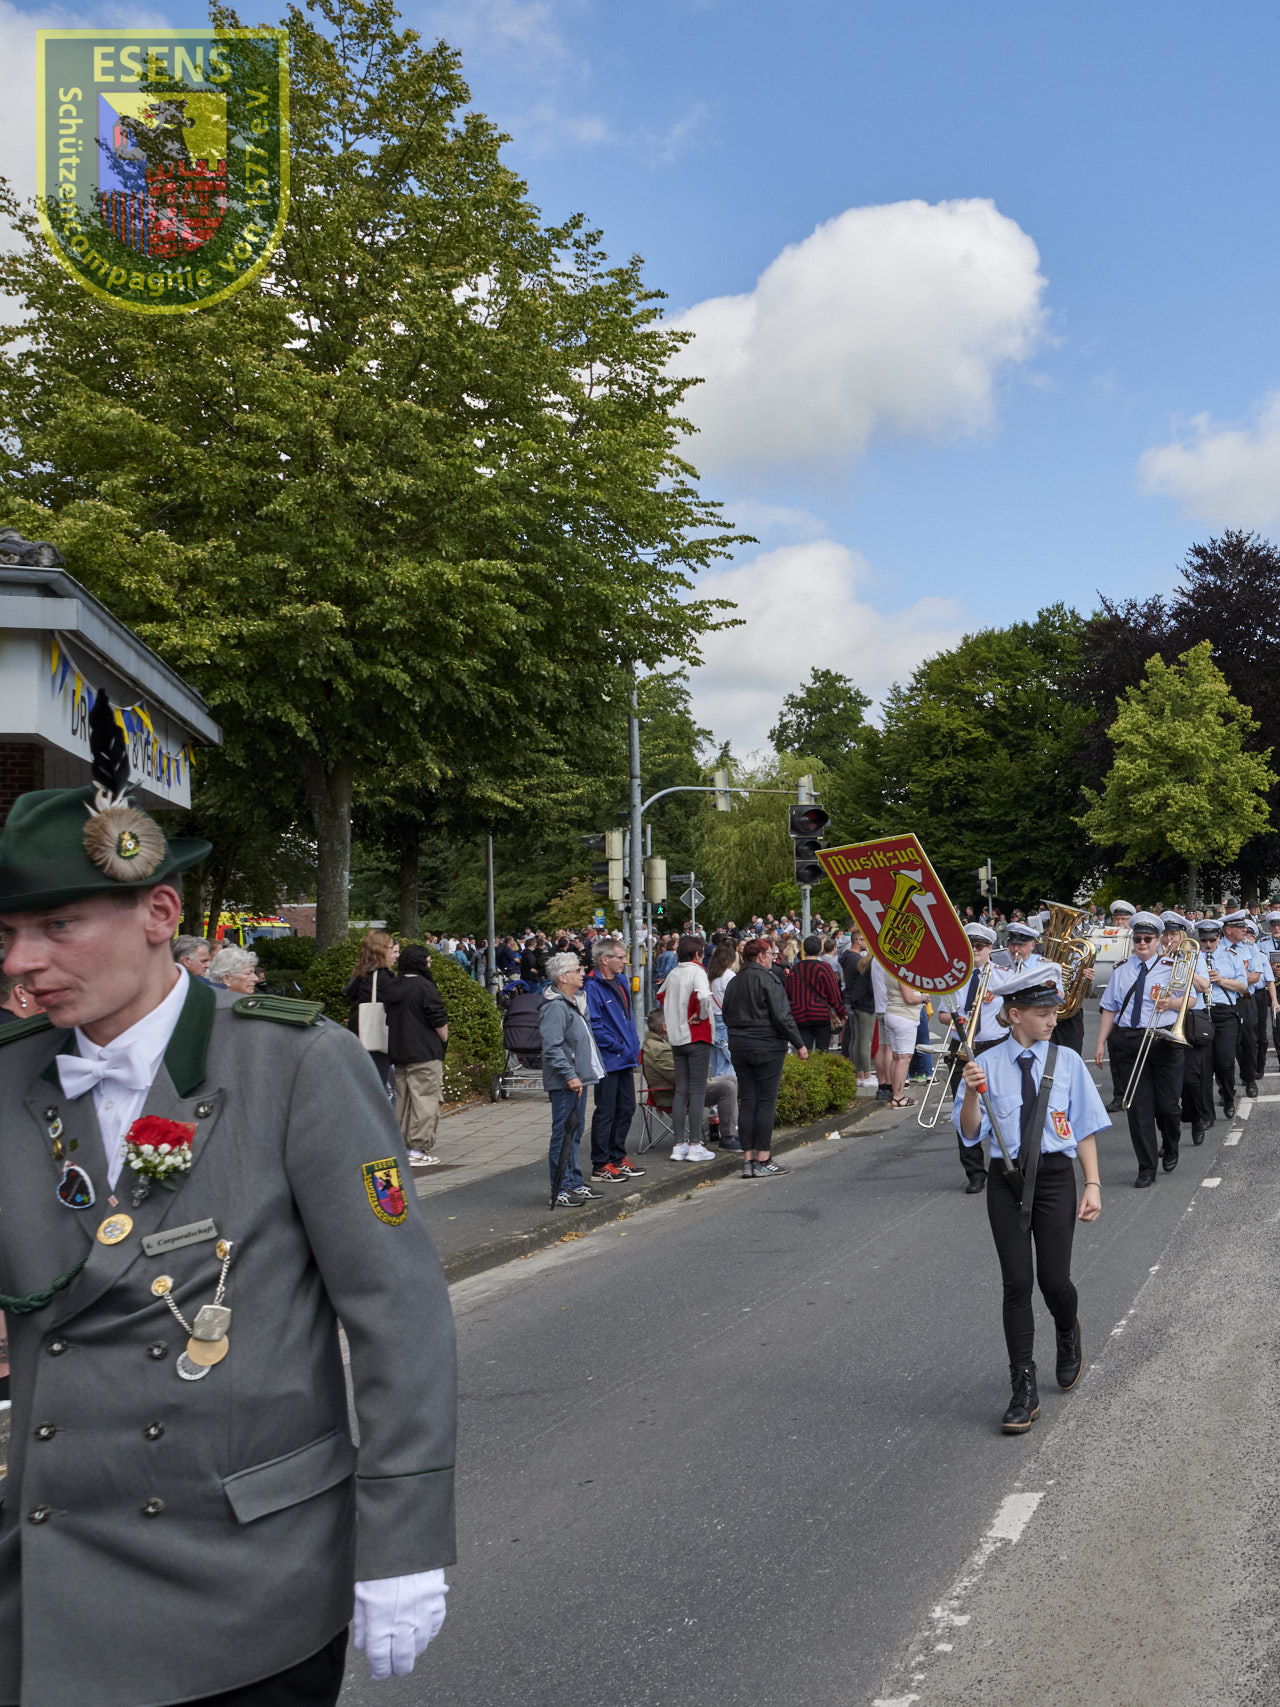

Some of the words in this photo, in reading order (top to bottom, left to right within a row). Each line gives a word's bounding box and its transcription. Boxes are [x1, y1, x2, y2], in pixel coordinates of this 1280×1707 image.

[827, 847, 922, 876] Musikzug
[897, 957, 967, 990] MIDDELS
[156, 1225, 214, 1247] Corporalschaft
